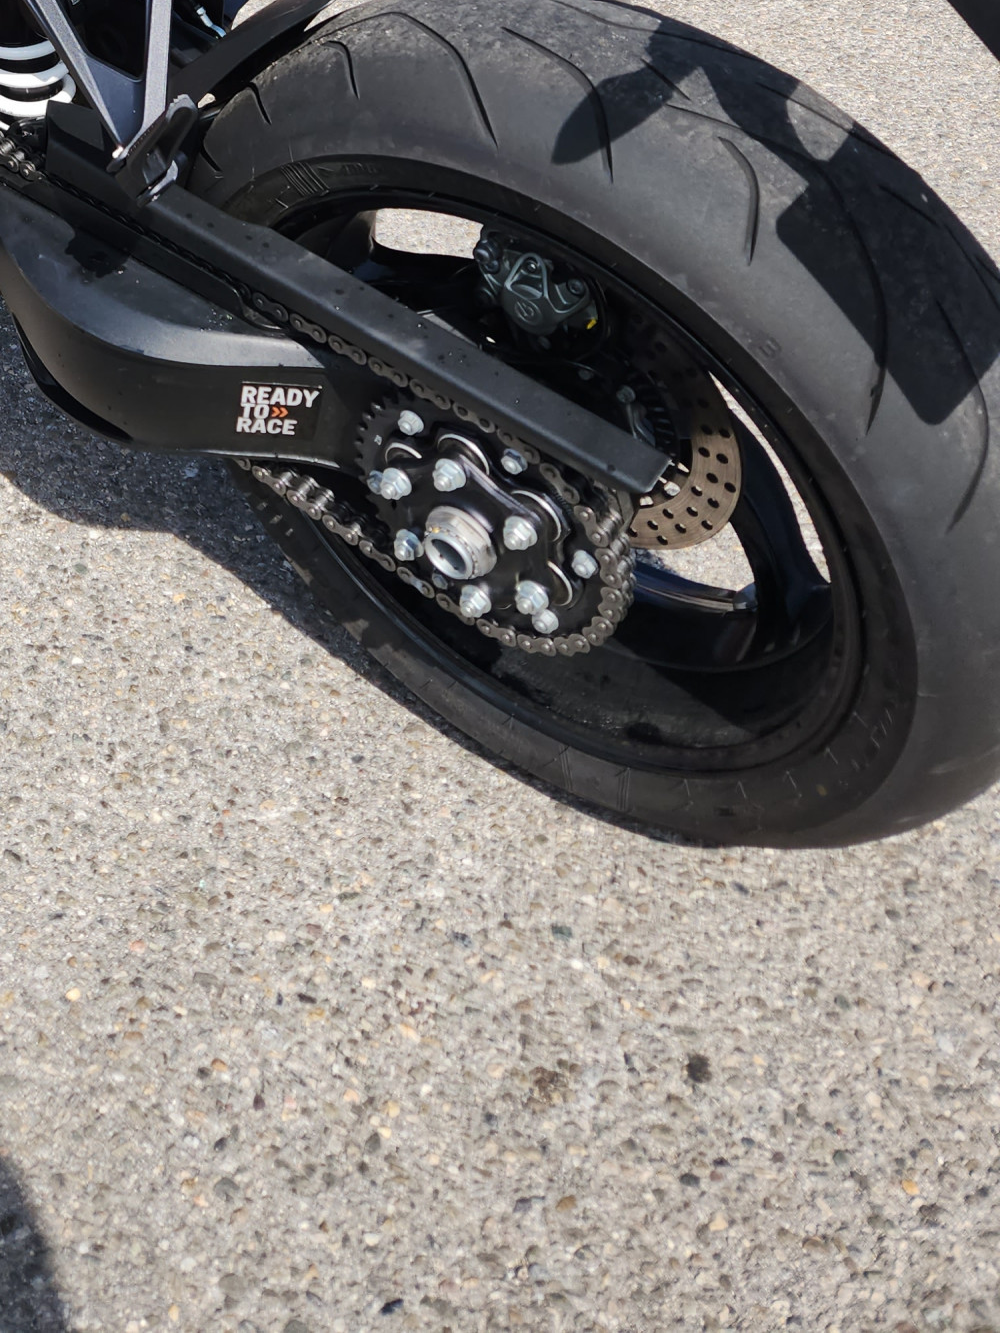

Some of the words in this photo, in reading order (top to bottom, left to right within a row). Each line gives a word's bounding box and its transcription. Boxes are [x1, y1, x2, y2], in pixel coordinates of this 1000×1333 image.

[241, 385, 320, 408] READY
[240, 403, 270, 419] TO
[236, 416, 298, 436] RACE
